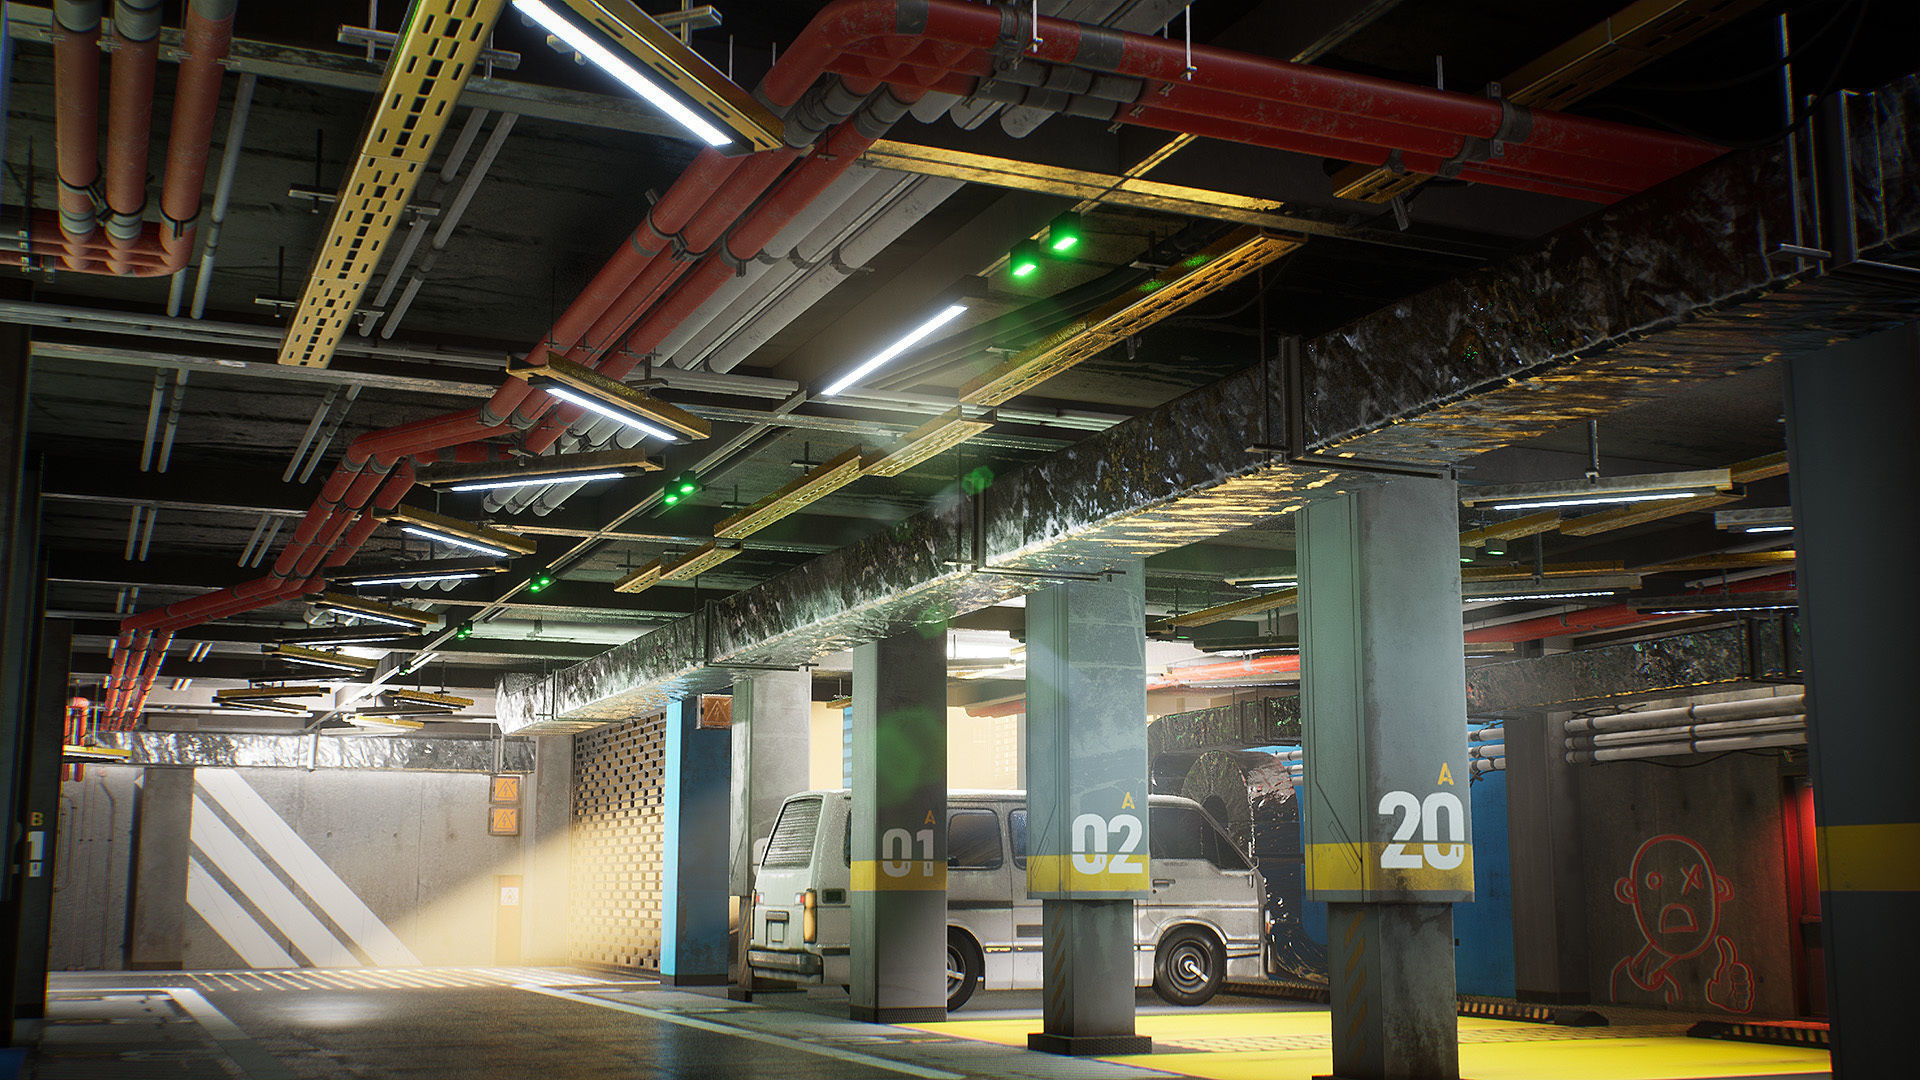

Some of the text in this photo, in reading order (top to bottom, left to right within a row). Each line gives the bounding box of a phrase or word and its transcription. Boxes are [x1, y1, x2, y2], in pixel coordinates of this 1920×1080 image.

[1437, 762, 1454, 786] A
[924, 809, 936, 825] A
[1121, 791, 1135, 809] A
[1072, 813, 1143, 875] 02
[1378, 790, 1465, 870] 20
[882, 828, 934, 877] 01
